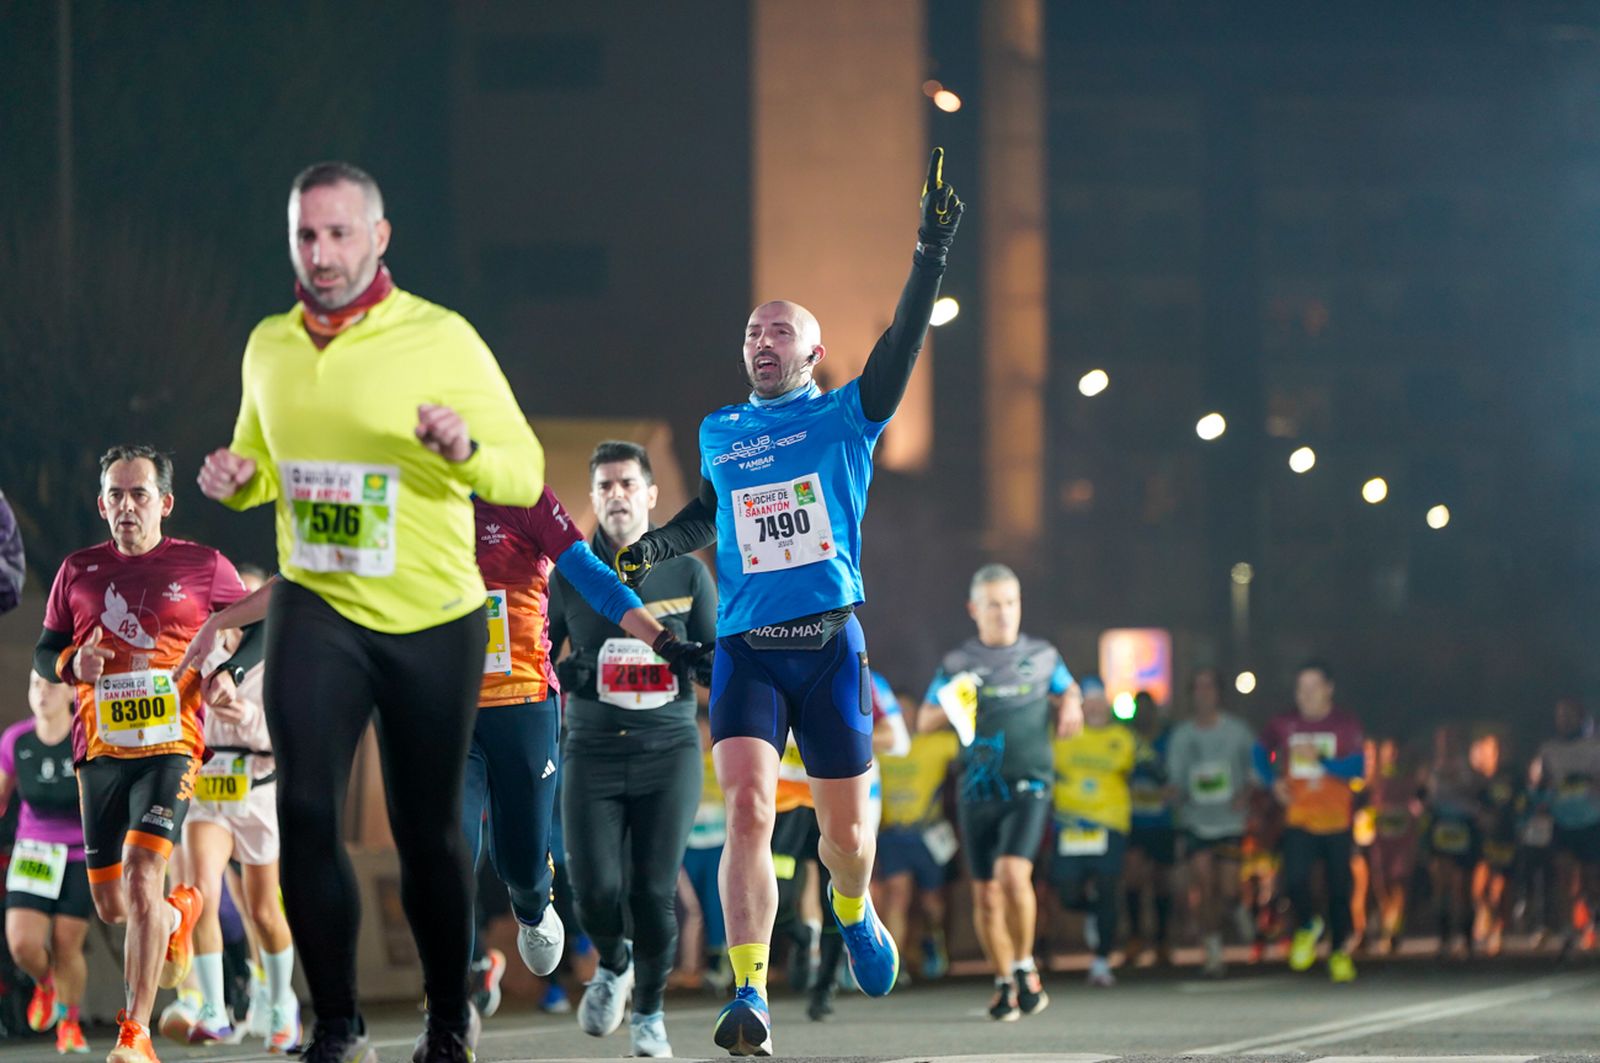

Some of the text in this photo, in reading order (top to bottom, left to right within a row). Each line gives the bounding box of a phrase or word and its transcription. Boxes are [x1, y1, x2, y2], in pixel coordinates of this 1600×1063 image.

[732, 435, 771, 451] CLUB
[745, 455, 775, 469] AMBAR
[778, 491, 788, 500] DE
[312, 502, 361, 537] 576
[755, 508, 811, 542] 7490
[118, 619, 138, 640] 43
[791, 622, 825, 637] MAX
[616, 665, 661, 685] 2818
[112, 681, 135, 689] NOCHE
[104, 688, 147, 700] SAN ANTÓN
[111, 697, 165, 723] 8300
